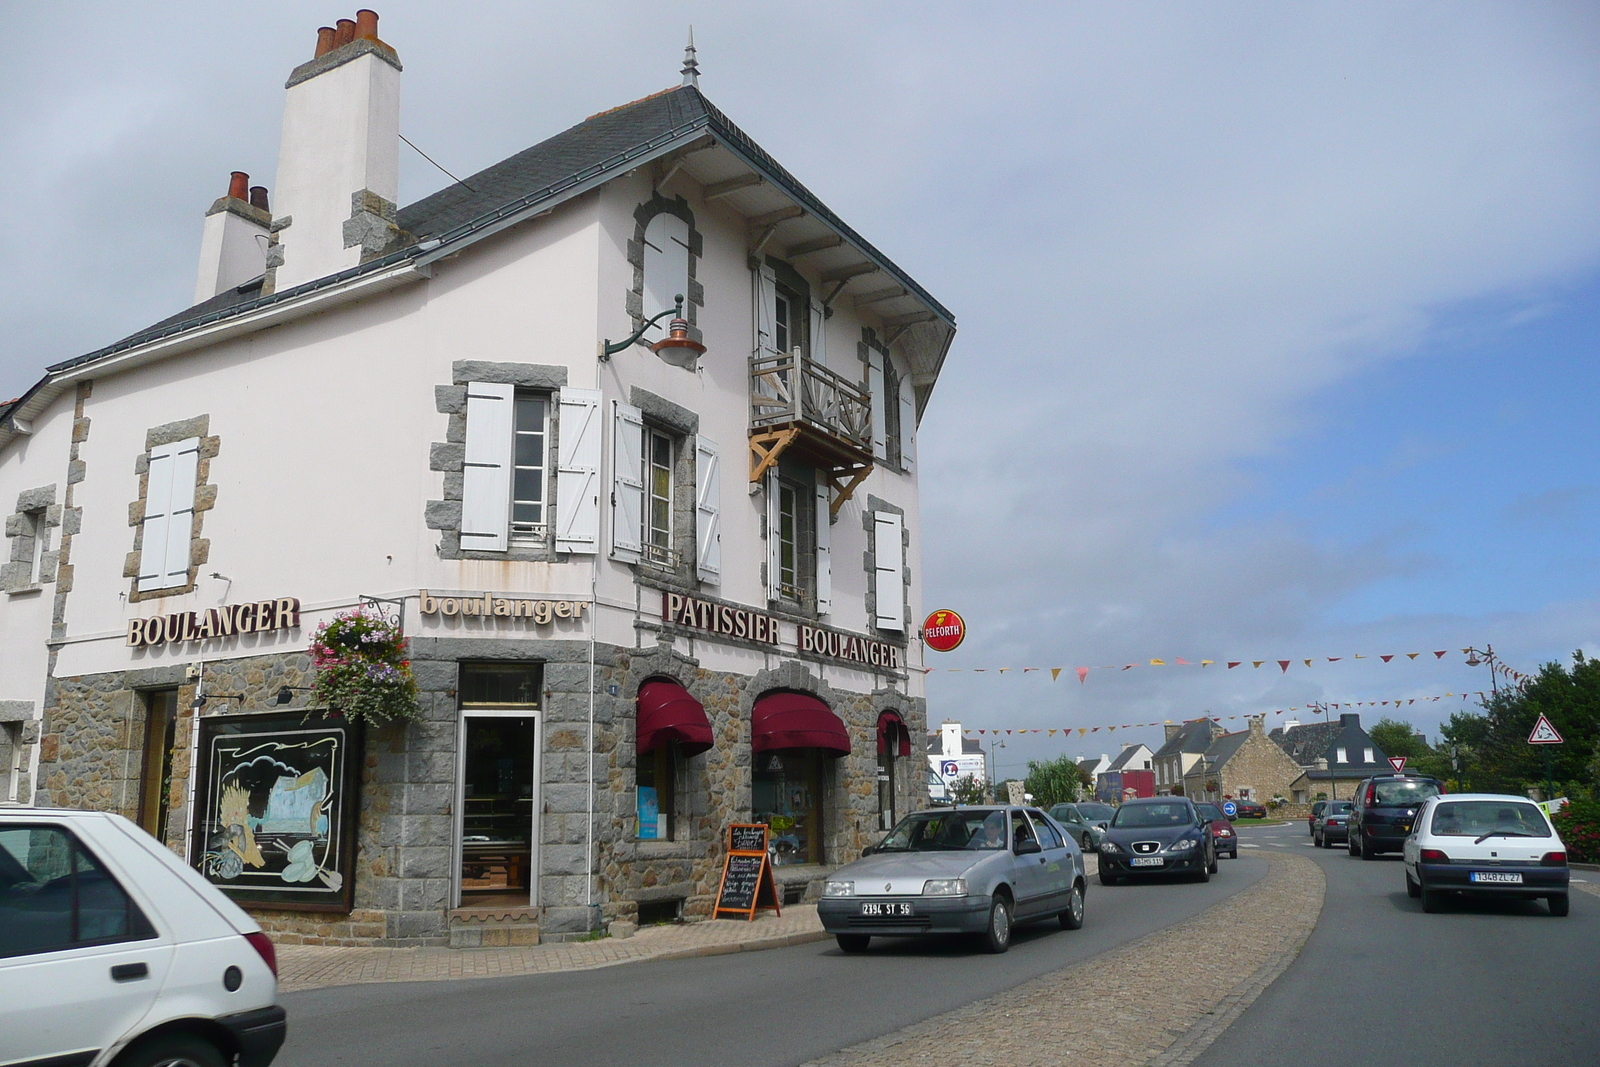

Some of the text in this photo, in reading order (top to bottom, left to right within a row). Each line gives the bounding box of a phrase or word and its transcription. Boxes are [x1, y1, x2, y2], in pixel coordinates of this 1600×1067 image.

[126, 597, 297, 647] BOULANGER
[419, 589, 588, 625] boulanger
[667, 592, 898, 669] PATISSIER BOULANGER
[925, 625, 960, 638] PELFORTH
[886, 904, 895, 915] ST
[900, 904, 910, 915] 56
